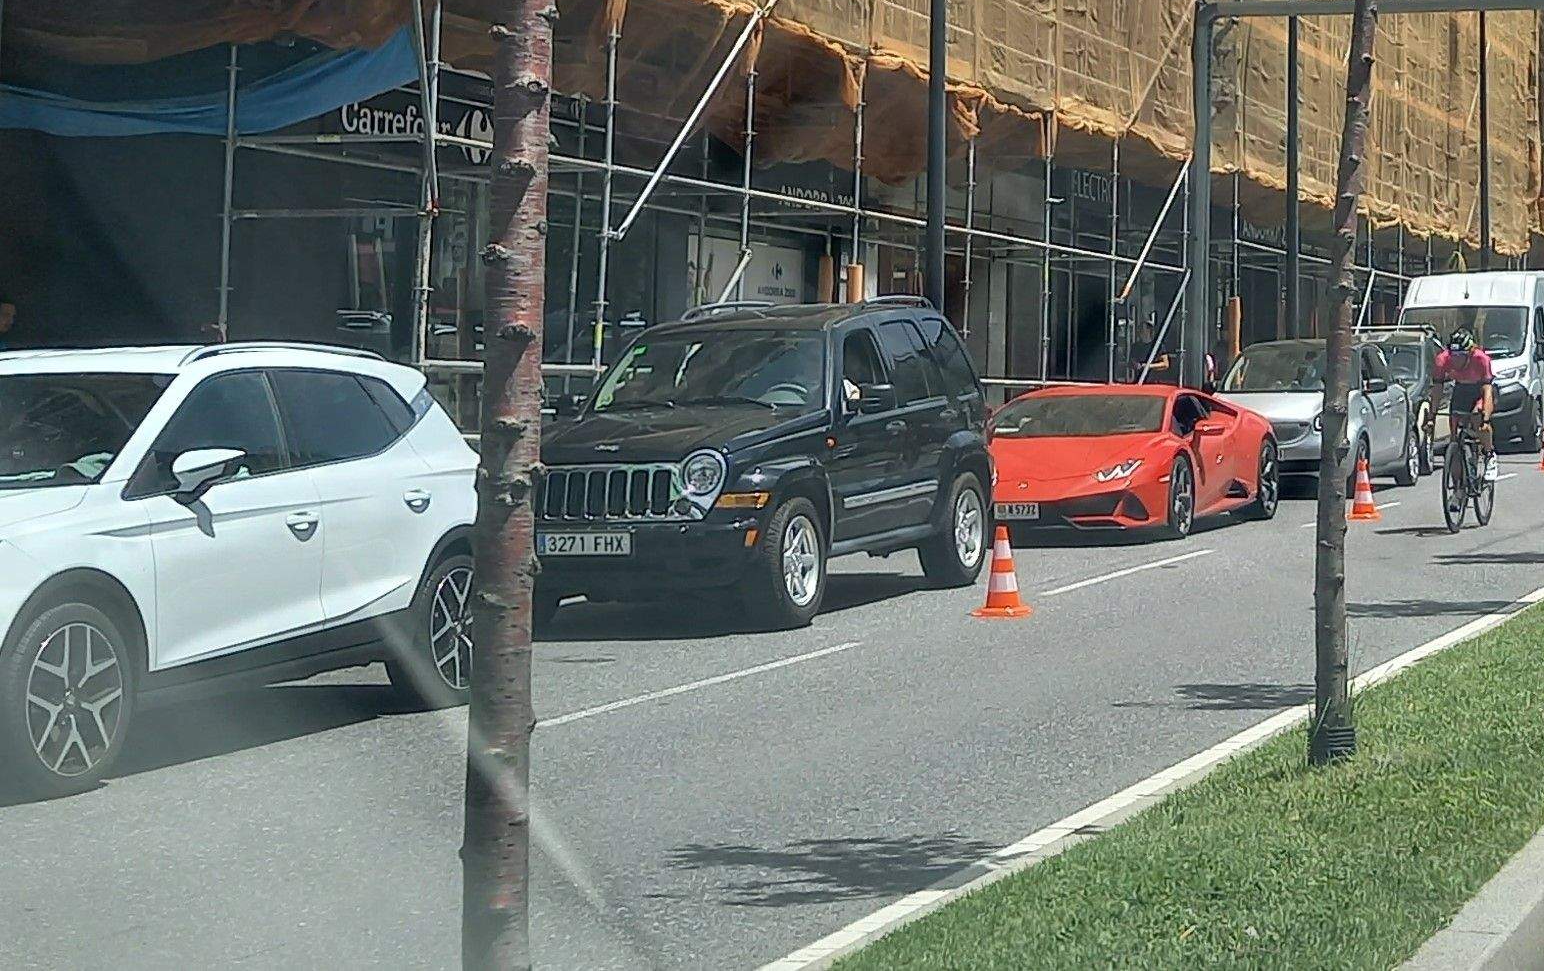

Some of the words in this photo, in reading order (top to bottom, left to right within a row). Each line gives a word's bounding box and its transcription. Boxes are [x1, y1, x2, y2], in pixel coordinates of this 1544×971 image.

[341, 102, 451, 146] Carrefor
[548, 536, 586, 553] 3271
[594, 536, 625, 552] FHX
